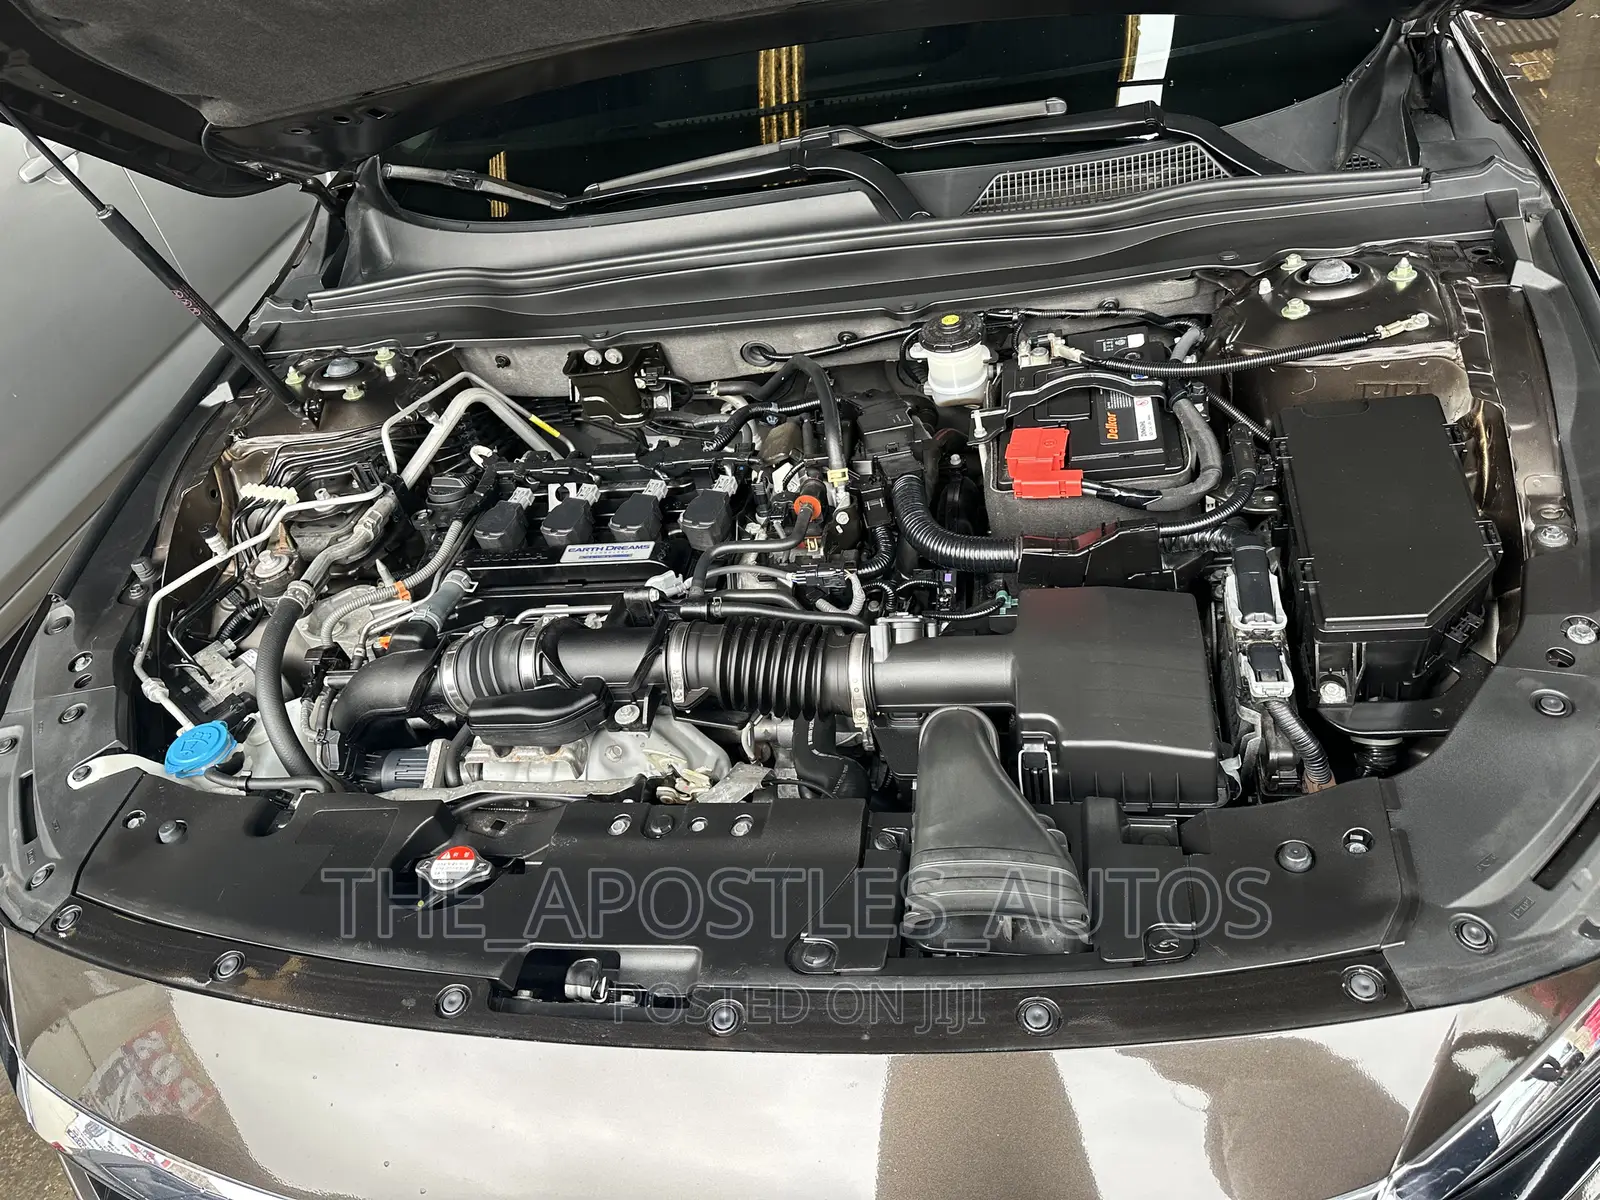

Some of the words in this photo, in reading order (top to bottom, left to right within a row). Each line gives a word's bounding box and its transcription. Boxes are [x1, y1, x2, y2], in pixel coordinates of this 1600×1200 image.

[1105, 411, 1119, 440] Delkor
[568, 545, 605, 553] EARTH
[605, 544, 650, 552] DREAMS
